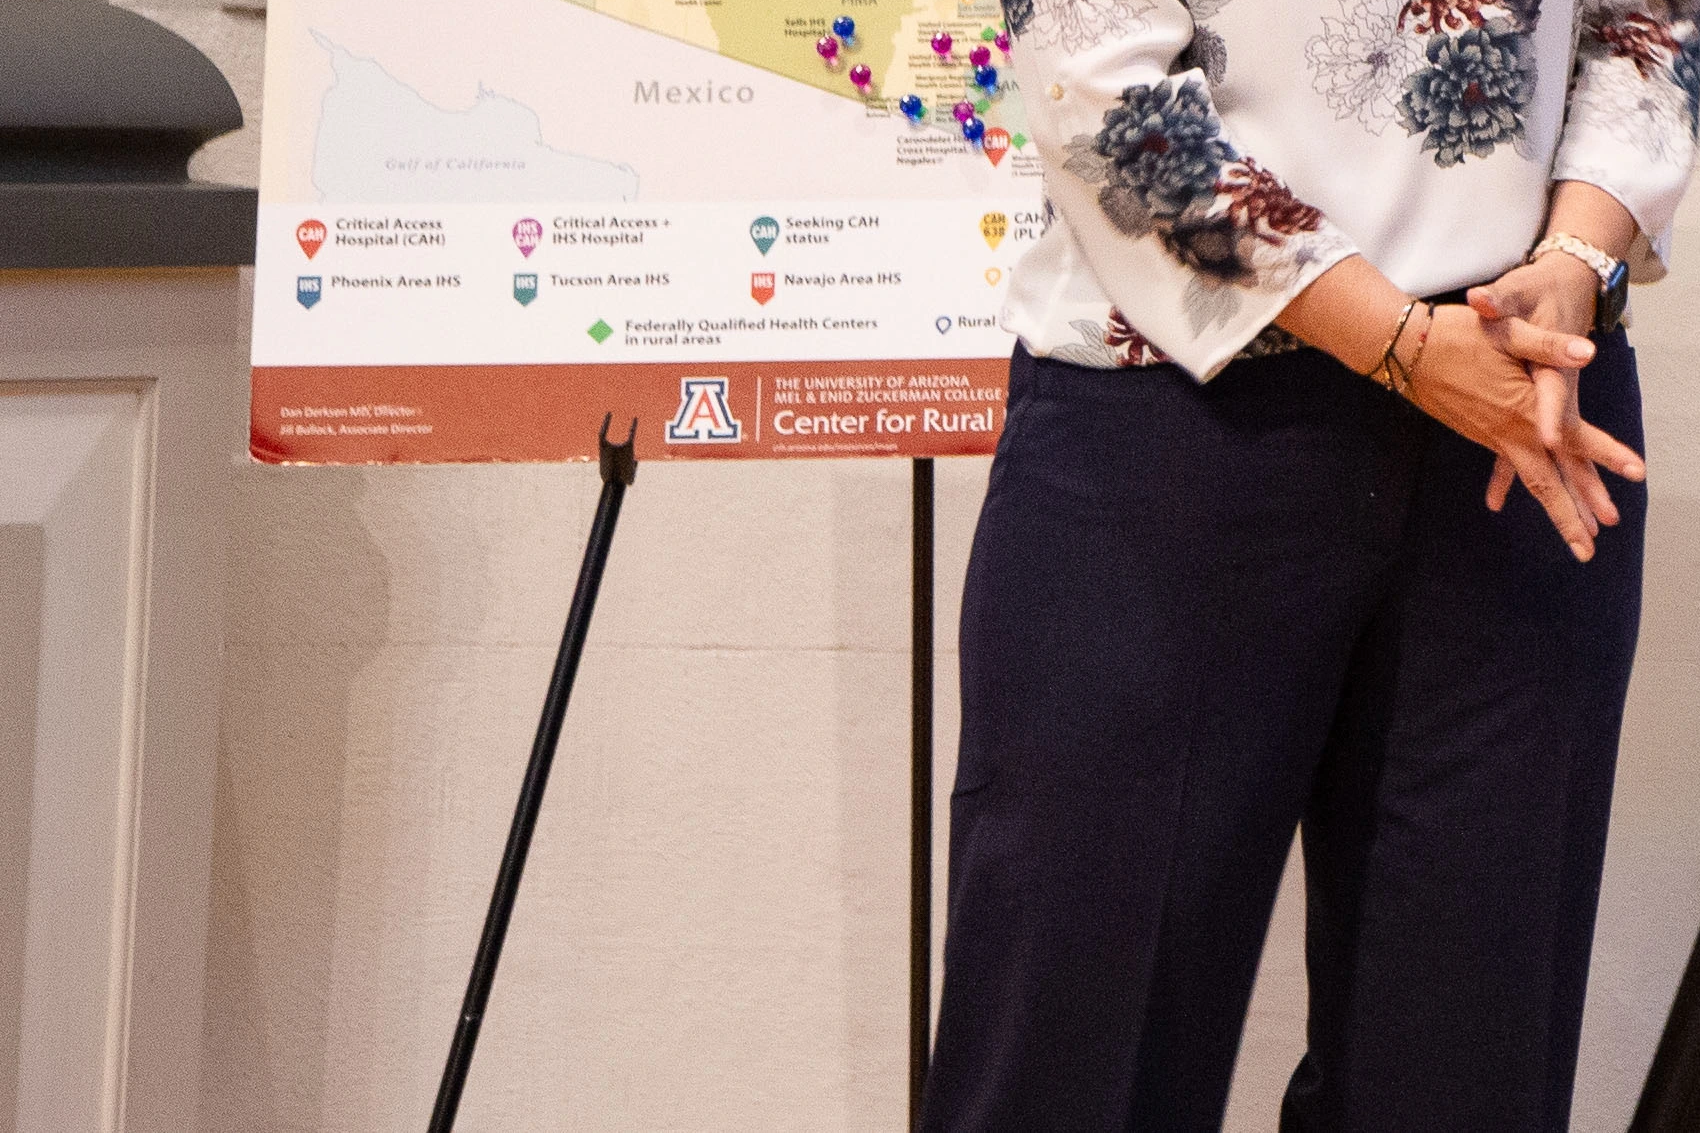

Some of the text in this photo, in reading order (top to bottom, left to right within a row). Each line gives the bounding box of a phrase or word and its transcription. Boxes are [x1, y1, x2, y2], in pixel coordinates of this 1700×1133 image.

[633, 80, 755, 105] Mexico
[336, 218, 442, 231] Critical Access
[552, 217, 606, 229] Critical
[609, 218, 660, 229] Access
[785, 216, 880, 231] Seeking CAH
[300, 227, 324, 242] CAH
[335, 232, 446, 247] Hospital (CAH)
[552, 231, 644, 246] IHS Hospital
[785, 232, 830, 244] status
[331, 275, 461, 288] Phoenix Area IHS
[550, 273, 670, 286] Tucson Area IHS
[784, 272, 902, 288] Navajo Area IHS
[625, 317, 878, 333] Federally Qualified Health Centers
[958, 315, 996, 328] Rural
[625, 334, 722, 346] in rural areas
[774, 375, 970, 390] THE UNIVERSITY OF ARIZONA
[774, 388, 1002, 404] MEL & ENID ZUCKERMAN COLLEGE
[773, 407, 994, 435] Center for Rural
[391, 424, 433, 435] Director
